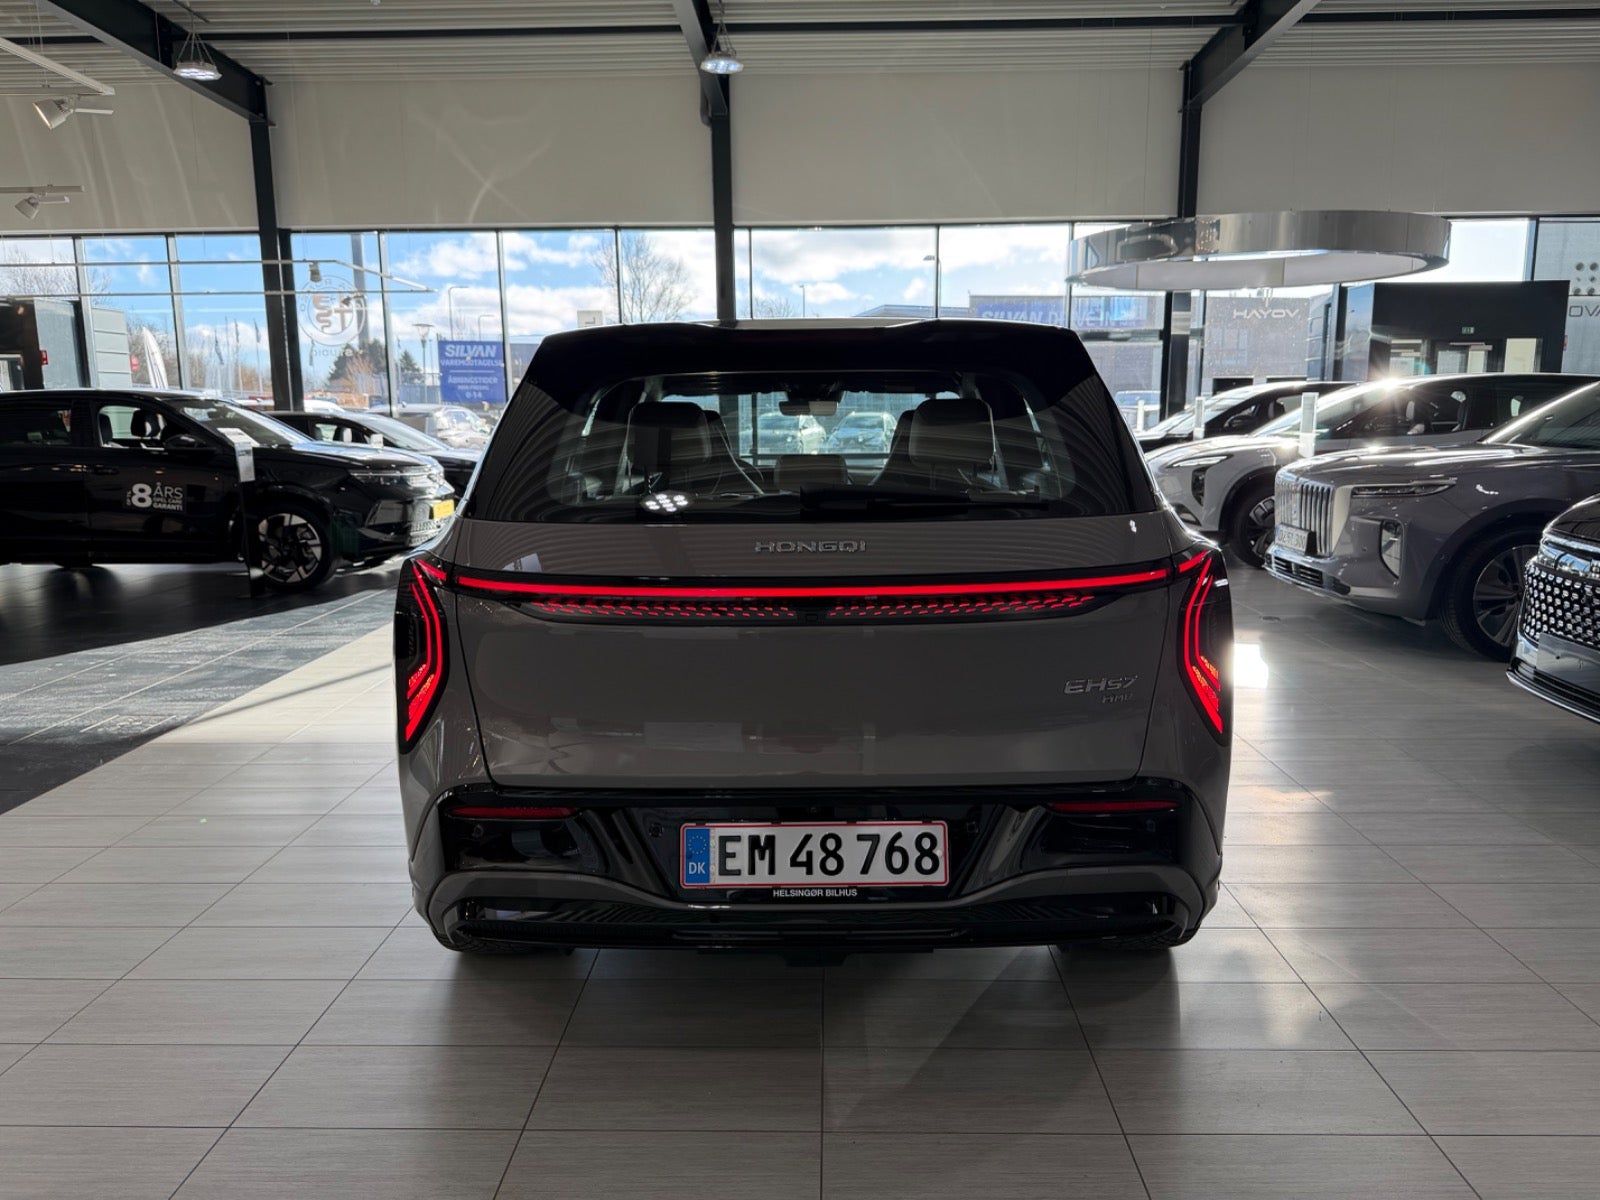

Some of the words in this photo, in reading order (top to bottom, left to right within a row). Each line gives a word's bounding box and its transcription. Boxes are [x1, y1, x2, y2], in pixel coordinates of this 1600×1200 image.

[444, 344, 497, 358] SILVAN
[132, 483, 152, 508] 8
[153, 481, 183, 499] ÅRS
[152, 502, 183, 511] GARANTI
[755, 541, 866, 553] HONGQI
[1064, 675, 1138, 694] EHS7
[718, 834, 776, 876] EM
[789, 832, 845, 876] 48
[856, 831, 940, 875] 768
[688, 862, 706, 875] DK
[773, 889, 824, 897] HELSINGØR
[825, 888, 858, 897] BILHUS
